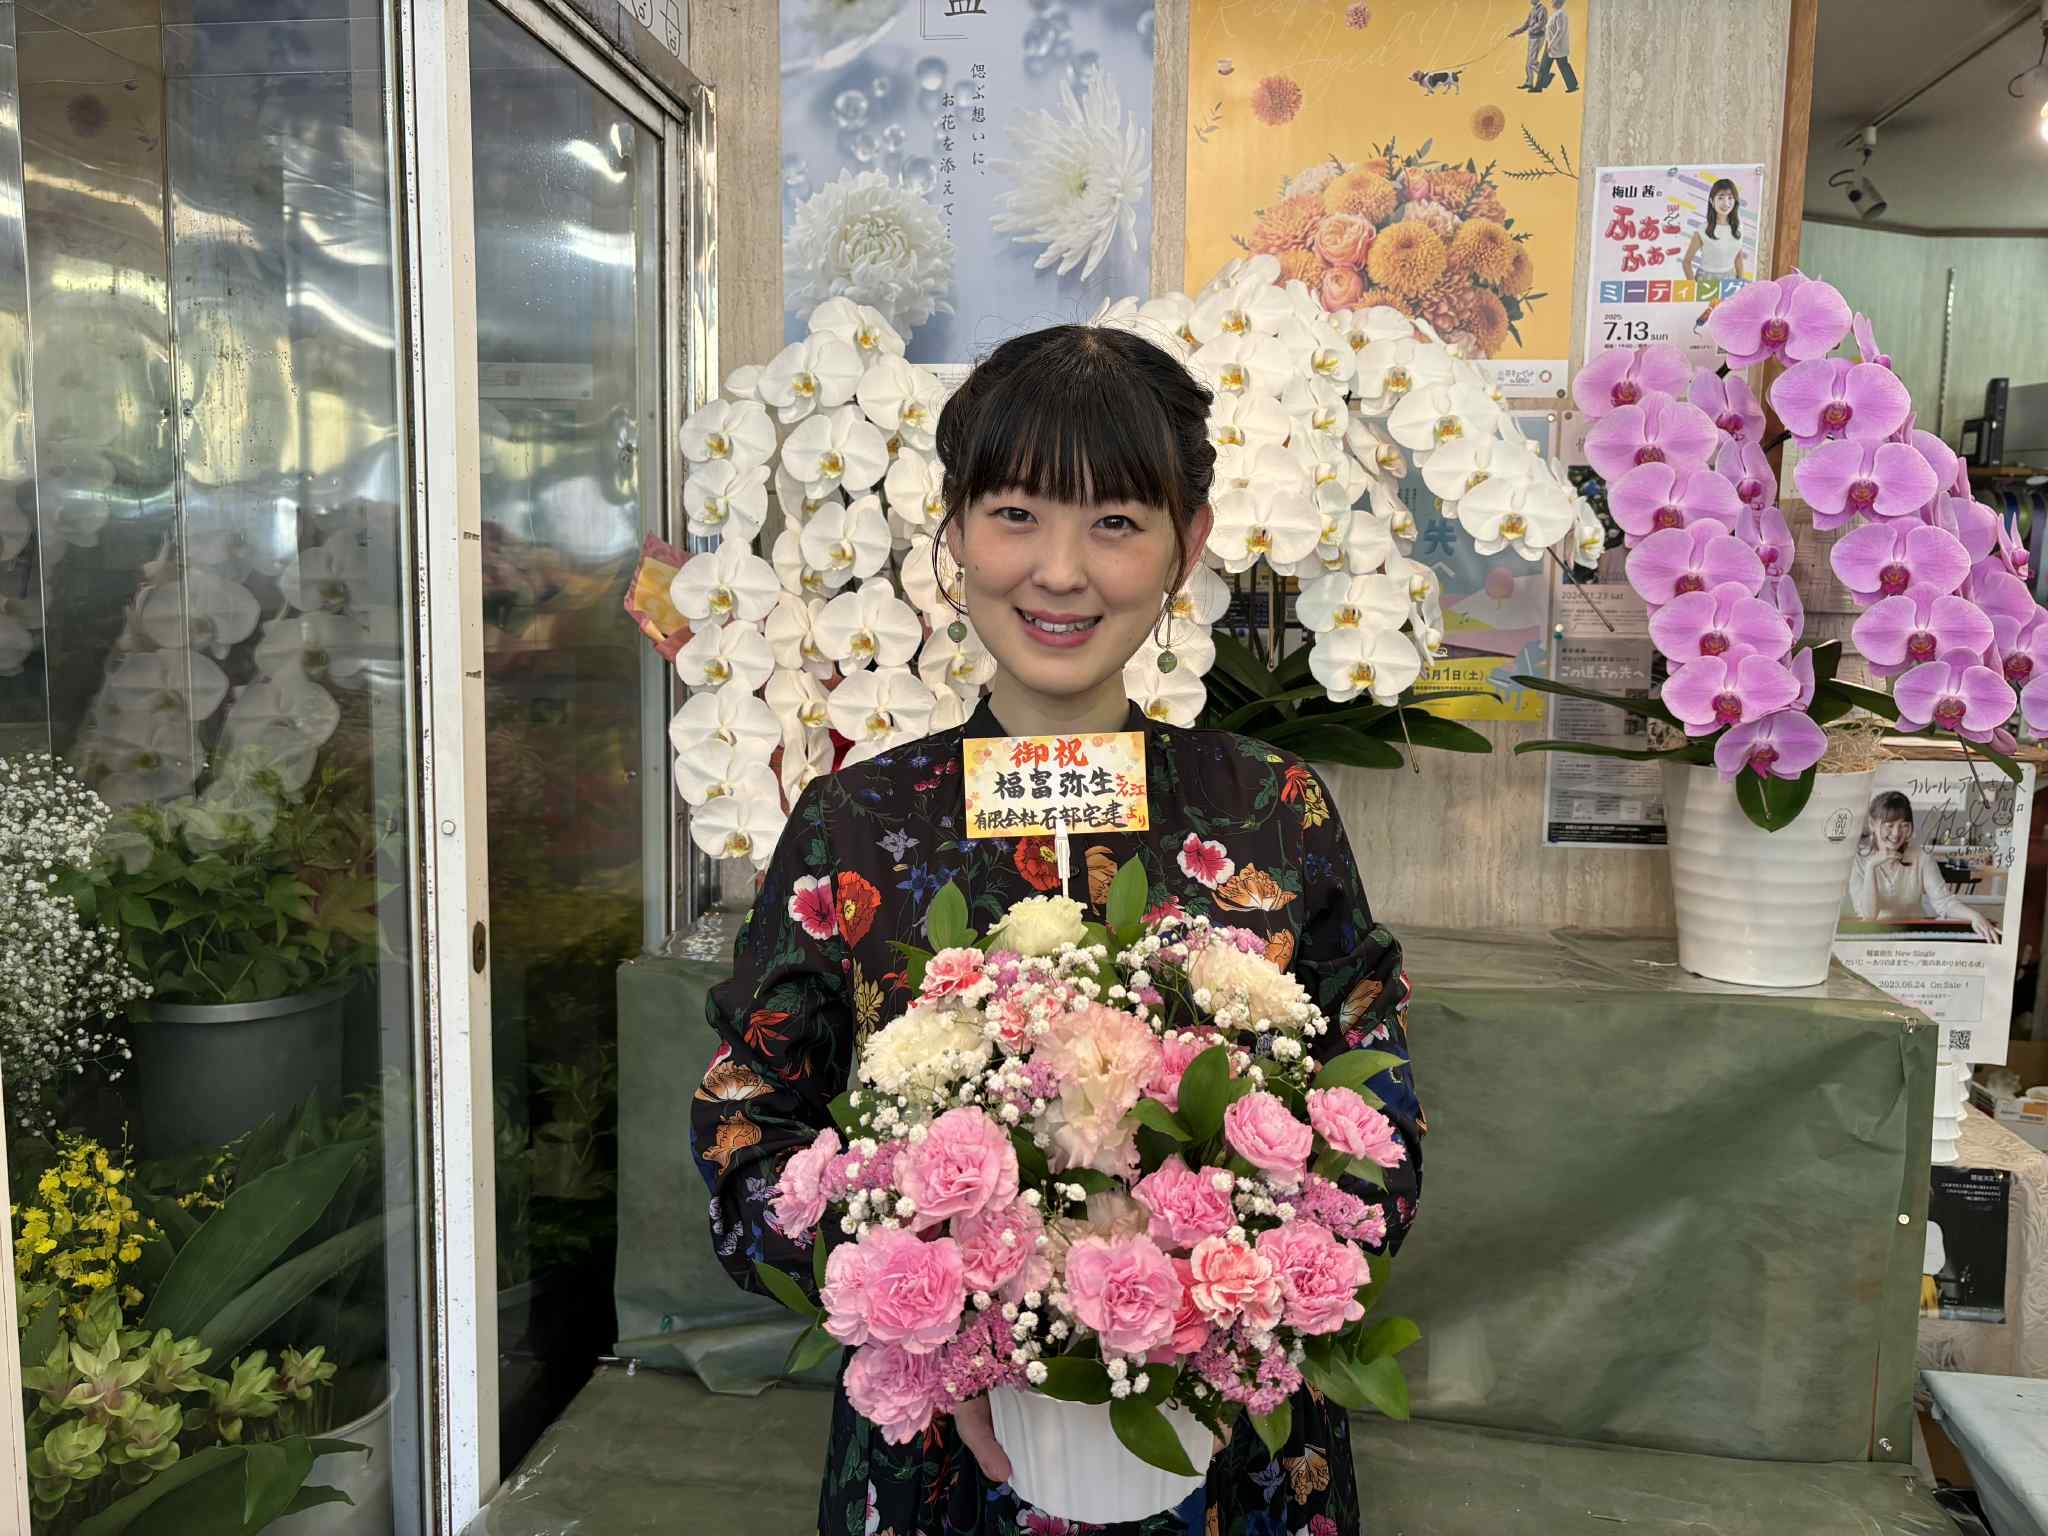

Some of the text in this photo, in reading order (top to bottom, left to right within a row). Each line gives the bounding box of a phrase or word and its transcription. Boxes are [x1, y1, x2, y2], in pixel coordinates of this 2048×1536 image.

[970, 63, 987, 176] 偲ぶ想いに、
[1603, 321, 1669, 341] 7.13 sun
[1009, 738, 1089, 768] 御祝
